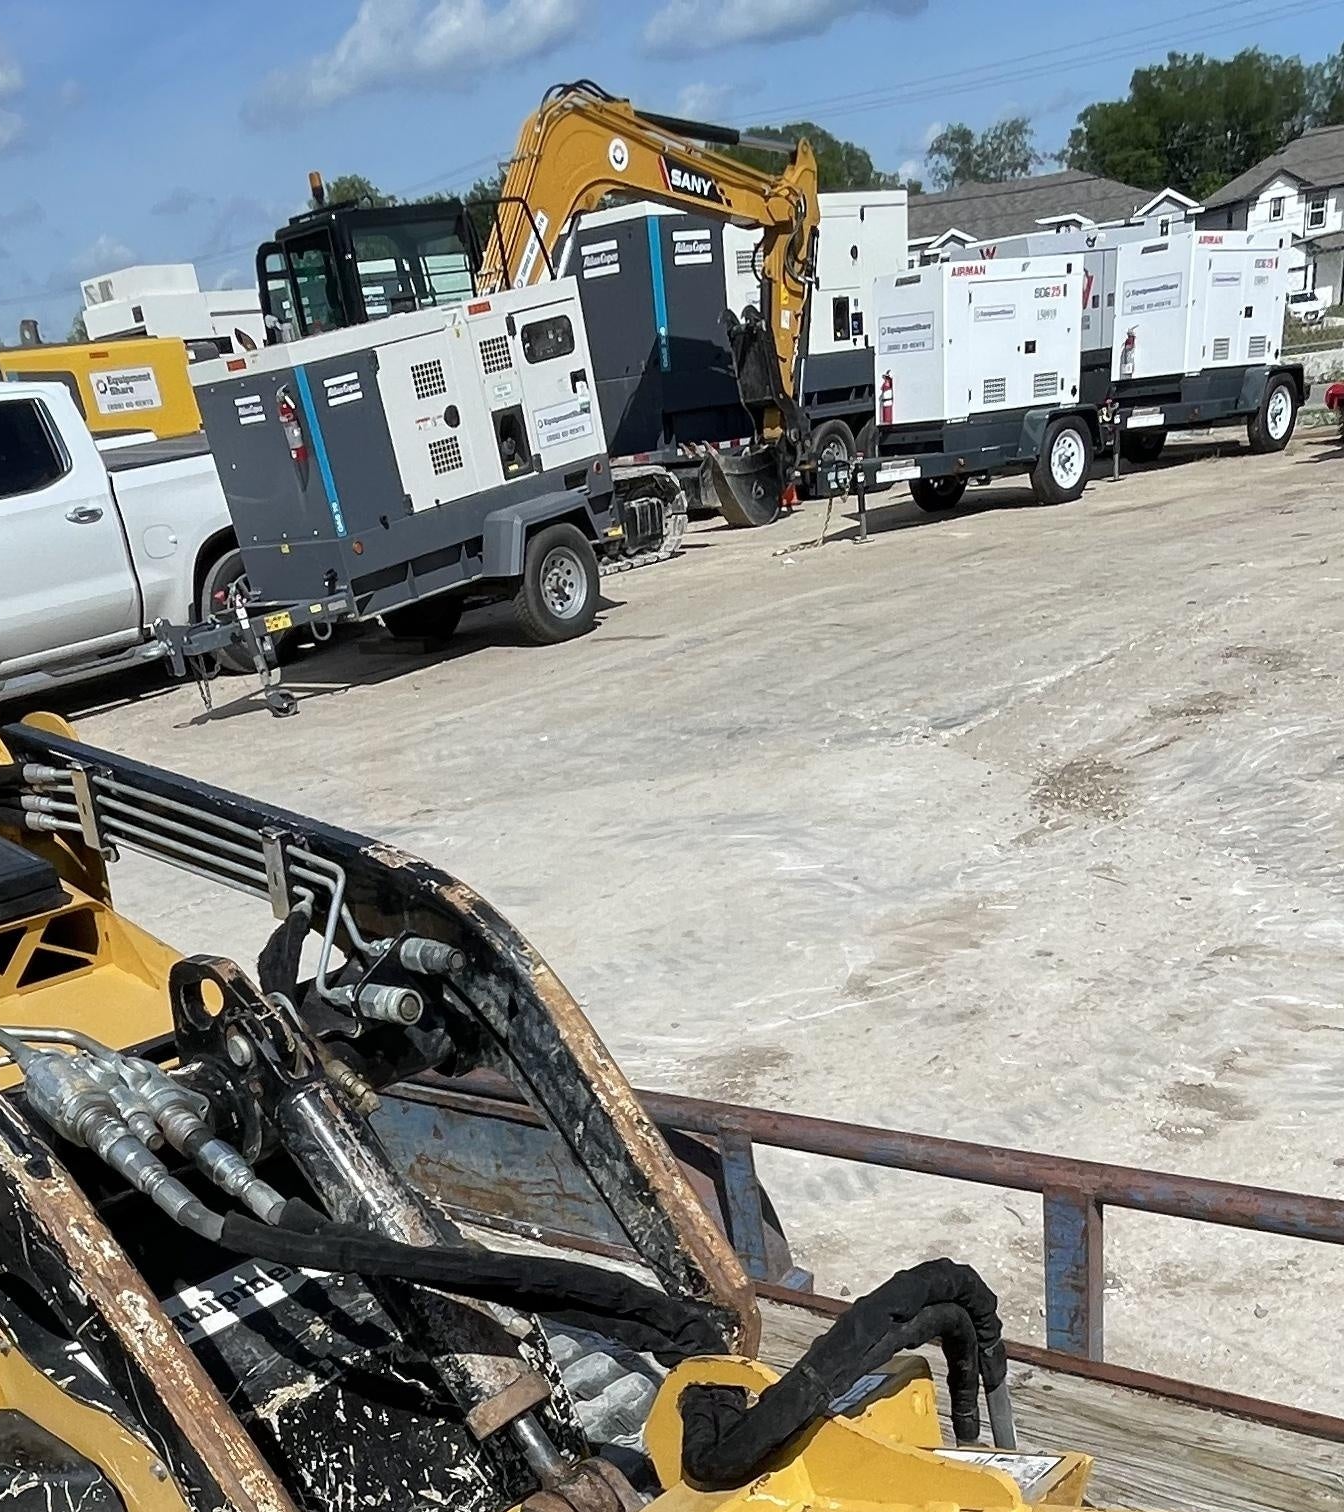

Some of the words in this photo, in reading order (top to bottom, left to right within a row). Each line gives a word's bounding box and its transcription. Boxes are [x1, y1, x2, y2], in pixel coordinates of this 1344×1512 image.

[671, 168, 712, 196] SANY
[951, 265, 986, 277] AIRMAN
[106, 372, 153, 388] Equipment
[109, 384, 135, 396] Share
